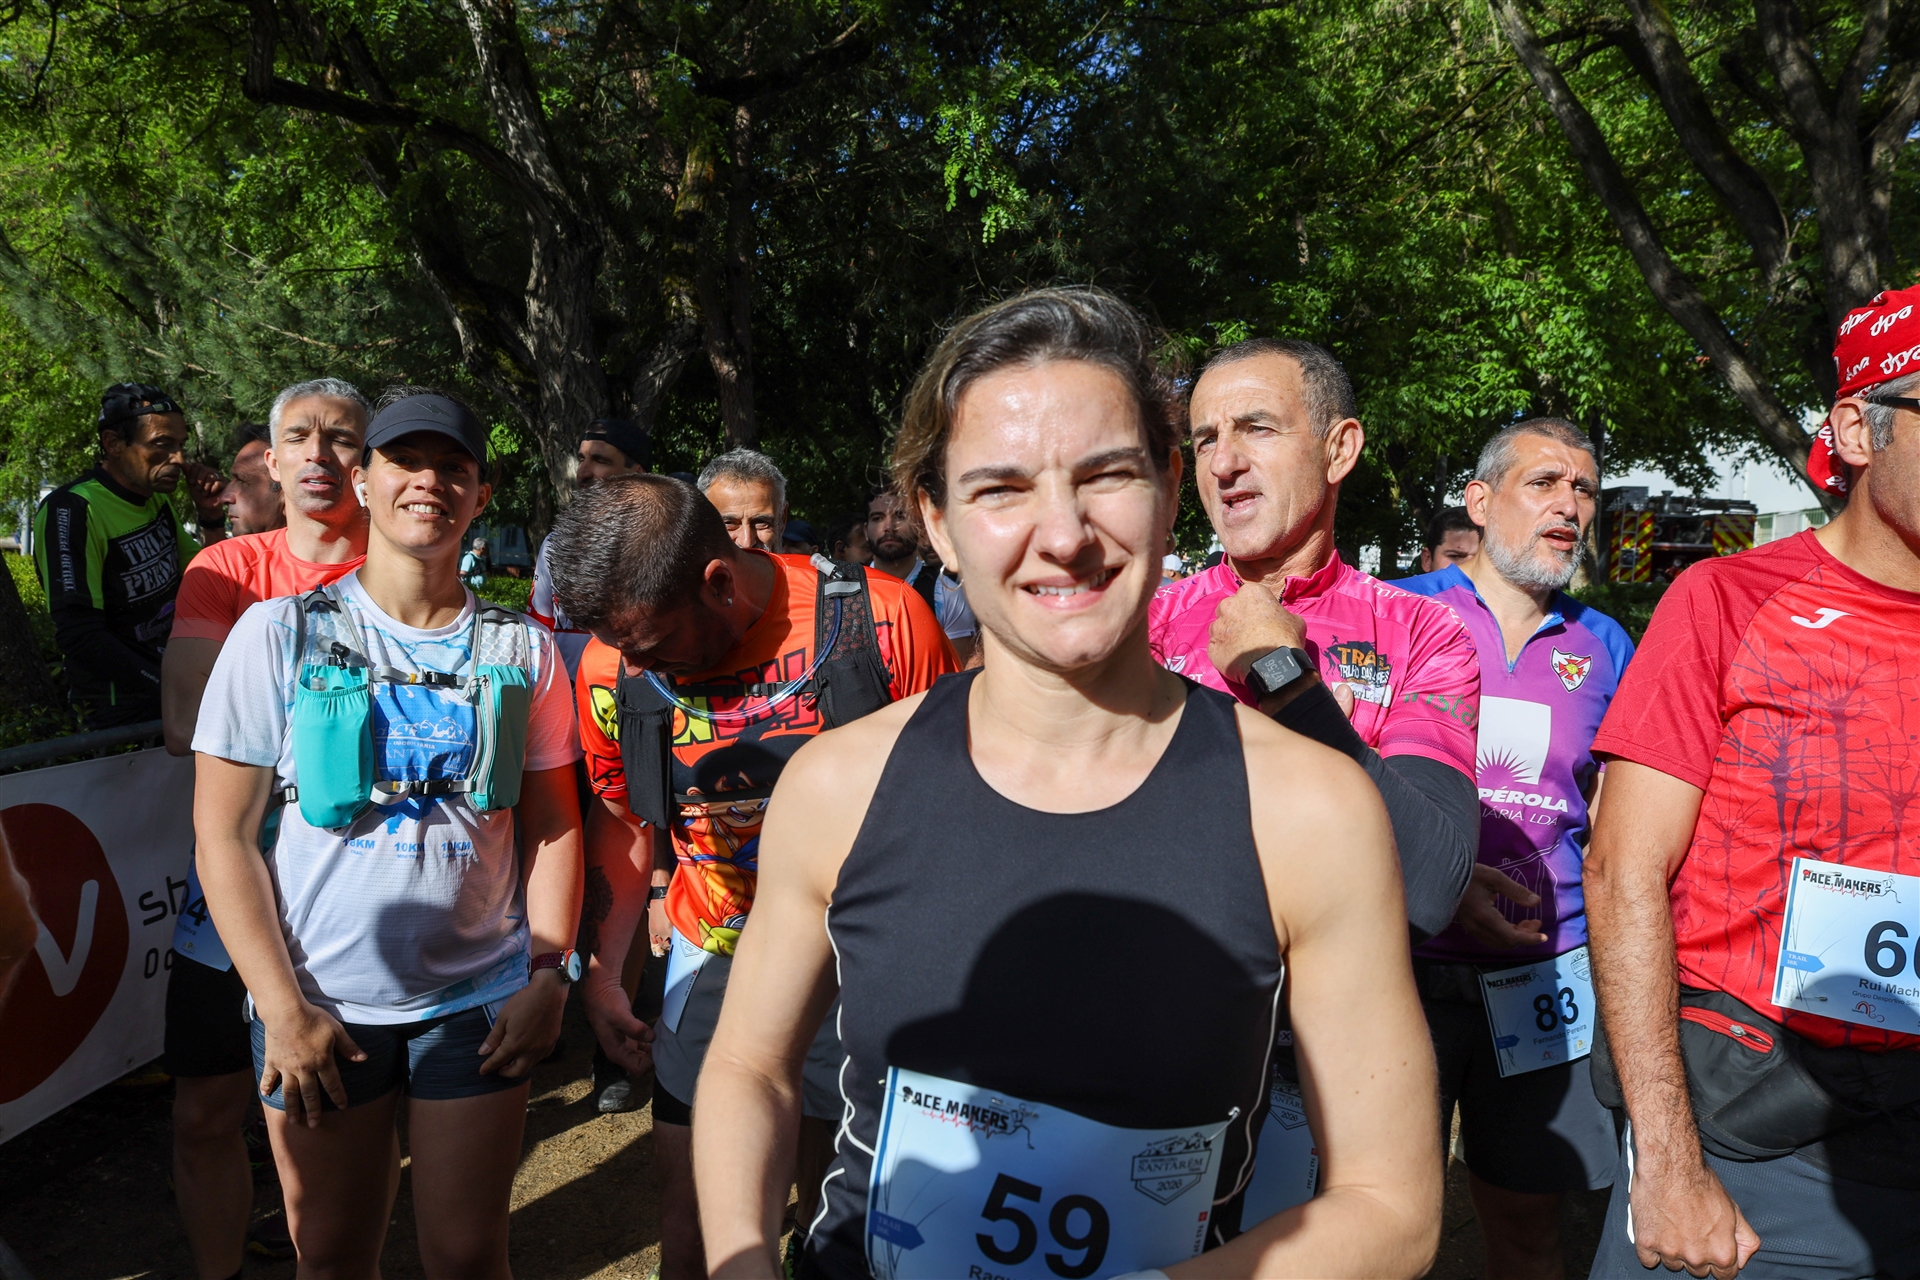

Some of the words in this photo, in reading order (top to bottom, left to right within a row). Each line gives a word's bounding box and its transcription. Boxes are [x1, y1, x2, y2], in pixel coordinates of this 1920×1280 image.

[1477, 786, 1569, 813] PÉROLA
[1529, 813, 1559, 826] LDA
[343, 837, 376, 850] 18KM
[394, 842, 426, 853] 10KM
[441, 841, 472, 851] 10KM
[1802, 869, 1882, 894] PACE.MAKERS
[1788, 953, 1808, 963] TRAIL
[1864, 920, 1920, 981] 6
[1858, 977, 1882, 992] Rui
[1885, 982, 1920, 998] Mach
[1851, 990, 1872, 1001] Grupo
[1872, 992, 1906, 1006] Desportivo
[1533, 986, 1579, 1032] 83
[1533, 1031, 1566, 1045] Fernando
[1566, 1024, 1587, 1036] Pereira
[901, 1085, 1009, 1130] PACE.MAKERS
[1137, 1156, 1204, 1173] SANTARÉM
[1156, 1179, 1183, 1192] 2026
[975, 1172, 1110, 1280] 59
